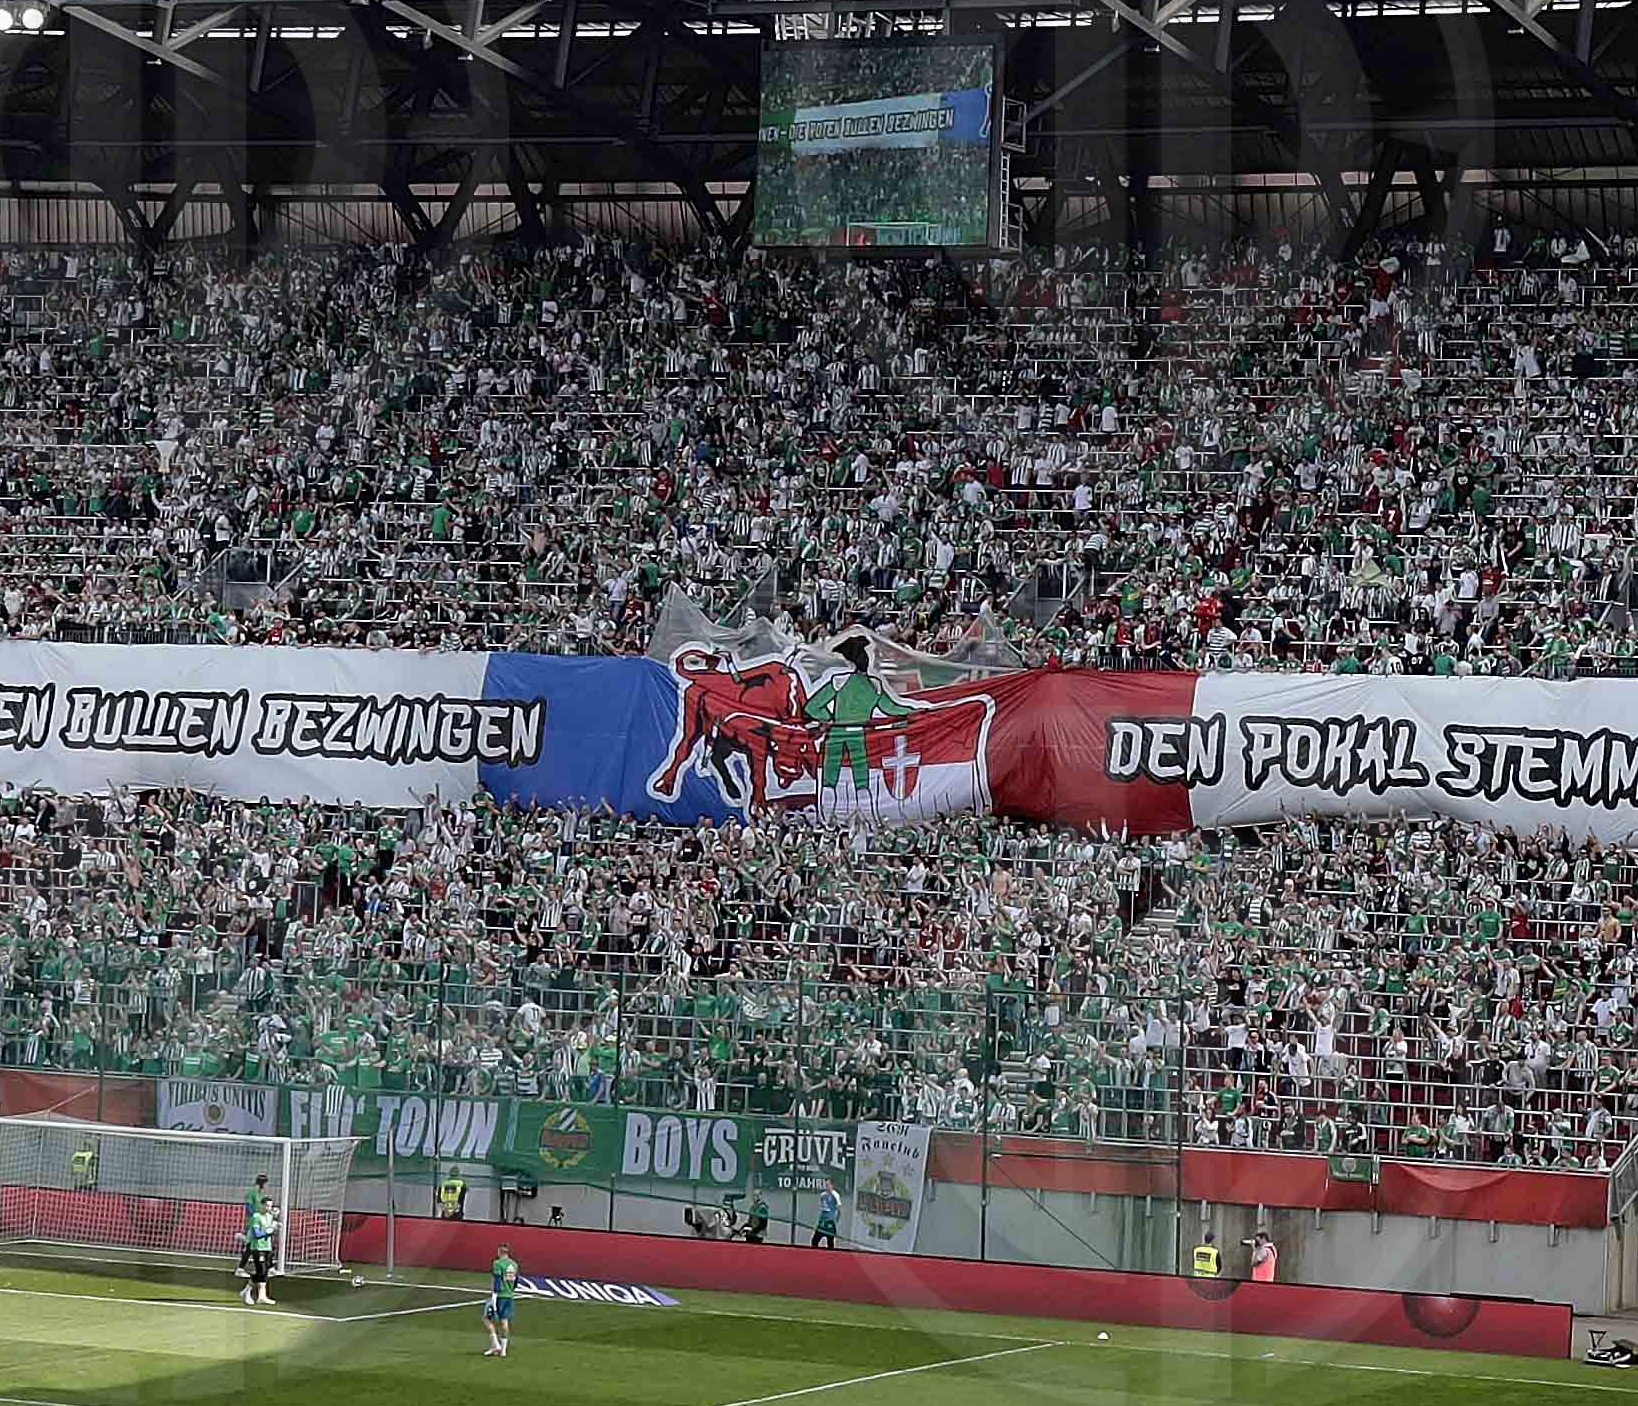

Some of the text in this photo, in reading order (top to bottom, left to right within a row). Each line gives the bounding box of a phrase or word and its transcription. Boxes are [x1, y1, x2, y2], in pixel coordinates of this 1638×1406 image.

[886, 108, 954, 133] BEZWINGEN
[61, 688, 246, 755] BULLEN
[255, 693, 545, 764] BEZWINGEN
[1105, 715, 1225, 784] DEN
[1243, 716, 1430, 795] POKAL
[376, 1096, 499, 1159] TOWN
[621, 1112, 740, 1184] BOYS
[763, 1128, 847, 1170] GRÜVE
[778, 1177, 791, 1188] 10
[546, 1278, 662, 1307] UNIQA
